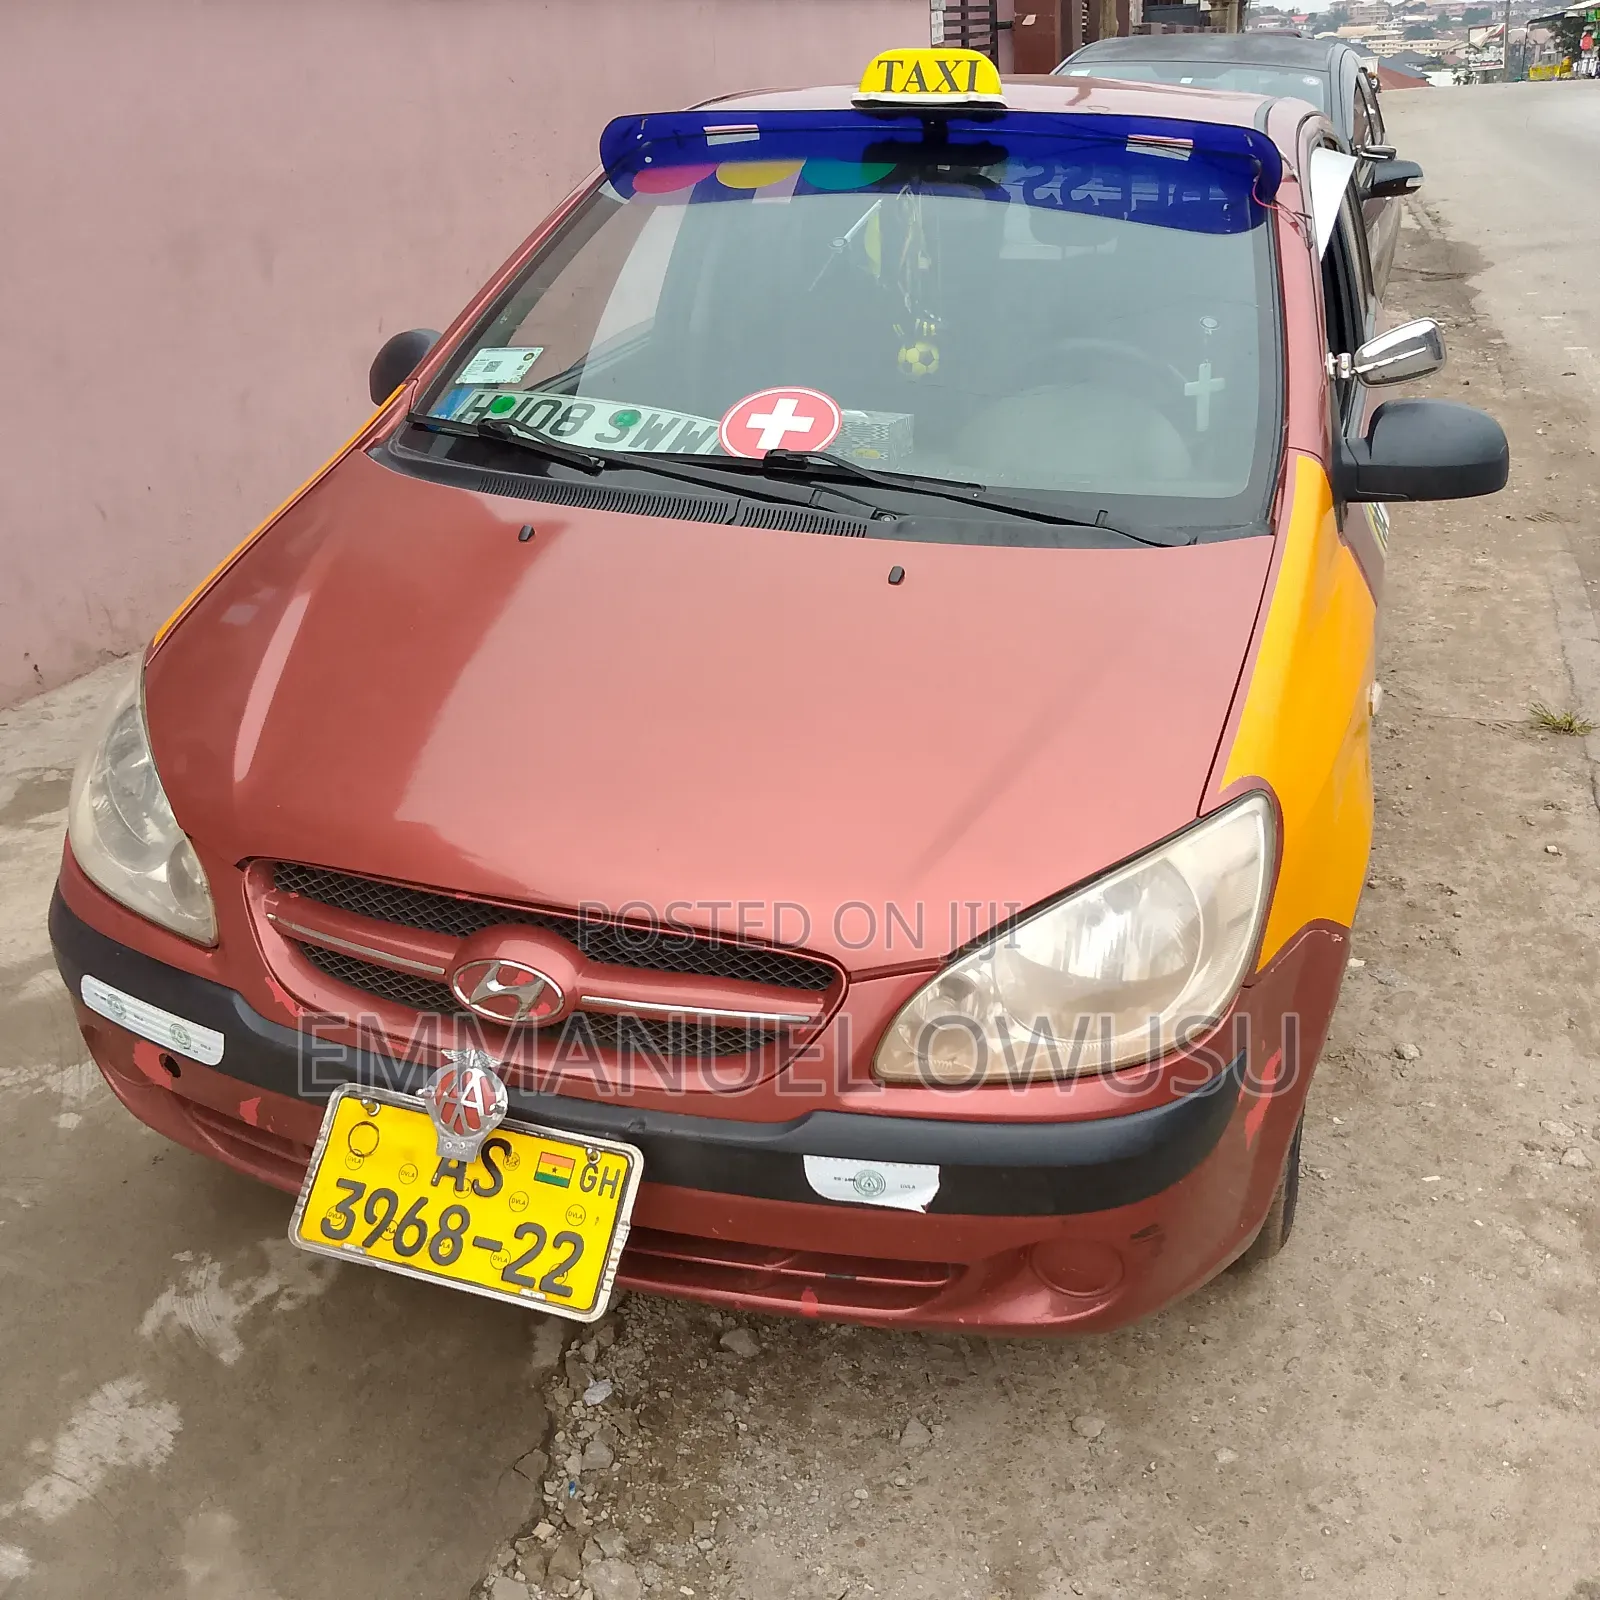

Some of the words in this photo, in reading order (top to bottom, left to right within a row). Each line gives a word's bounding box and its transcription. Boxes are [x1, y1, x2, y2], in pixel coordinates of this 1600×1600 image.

[877, 60, 981, 92] TAXI
[430, 1137, 512, 1197] AS
[579, 1163, 621, 1199] GH
[320, 1177, 585, 1298] 3968-22
